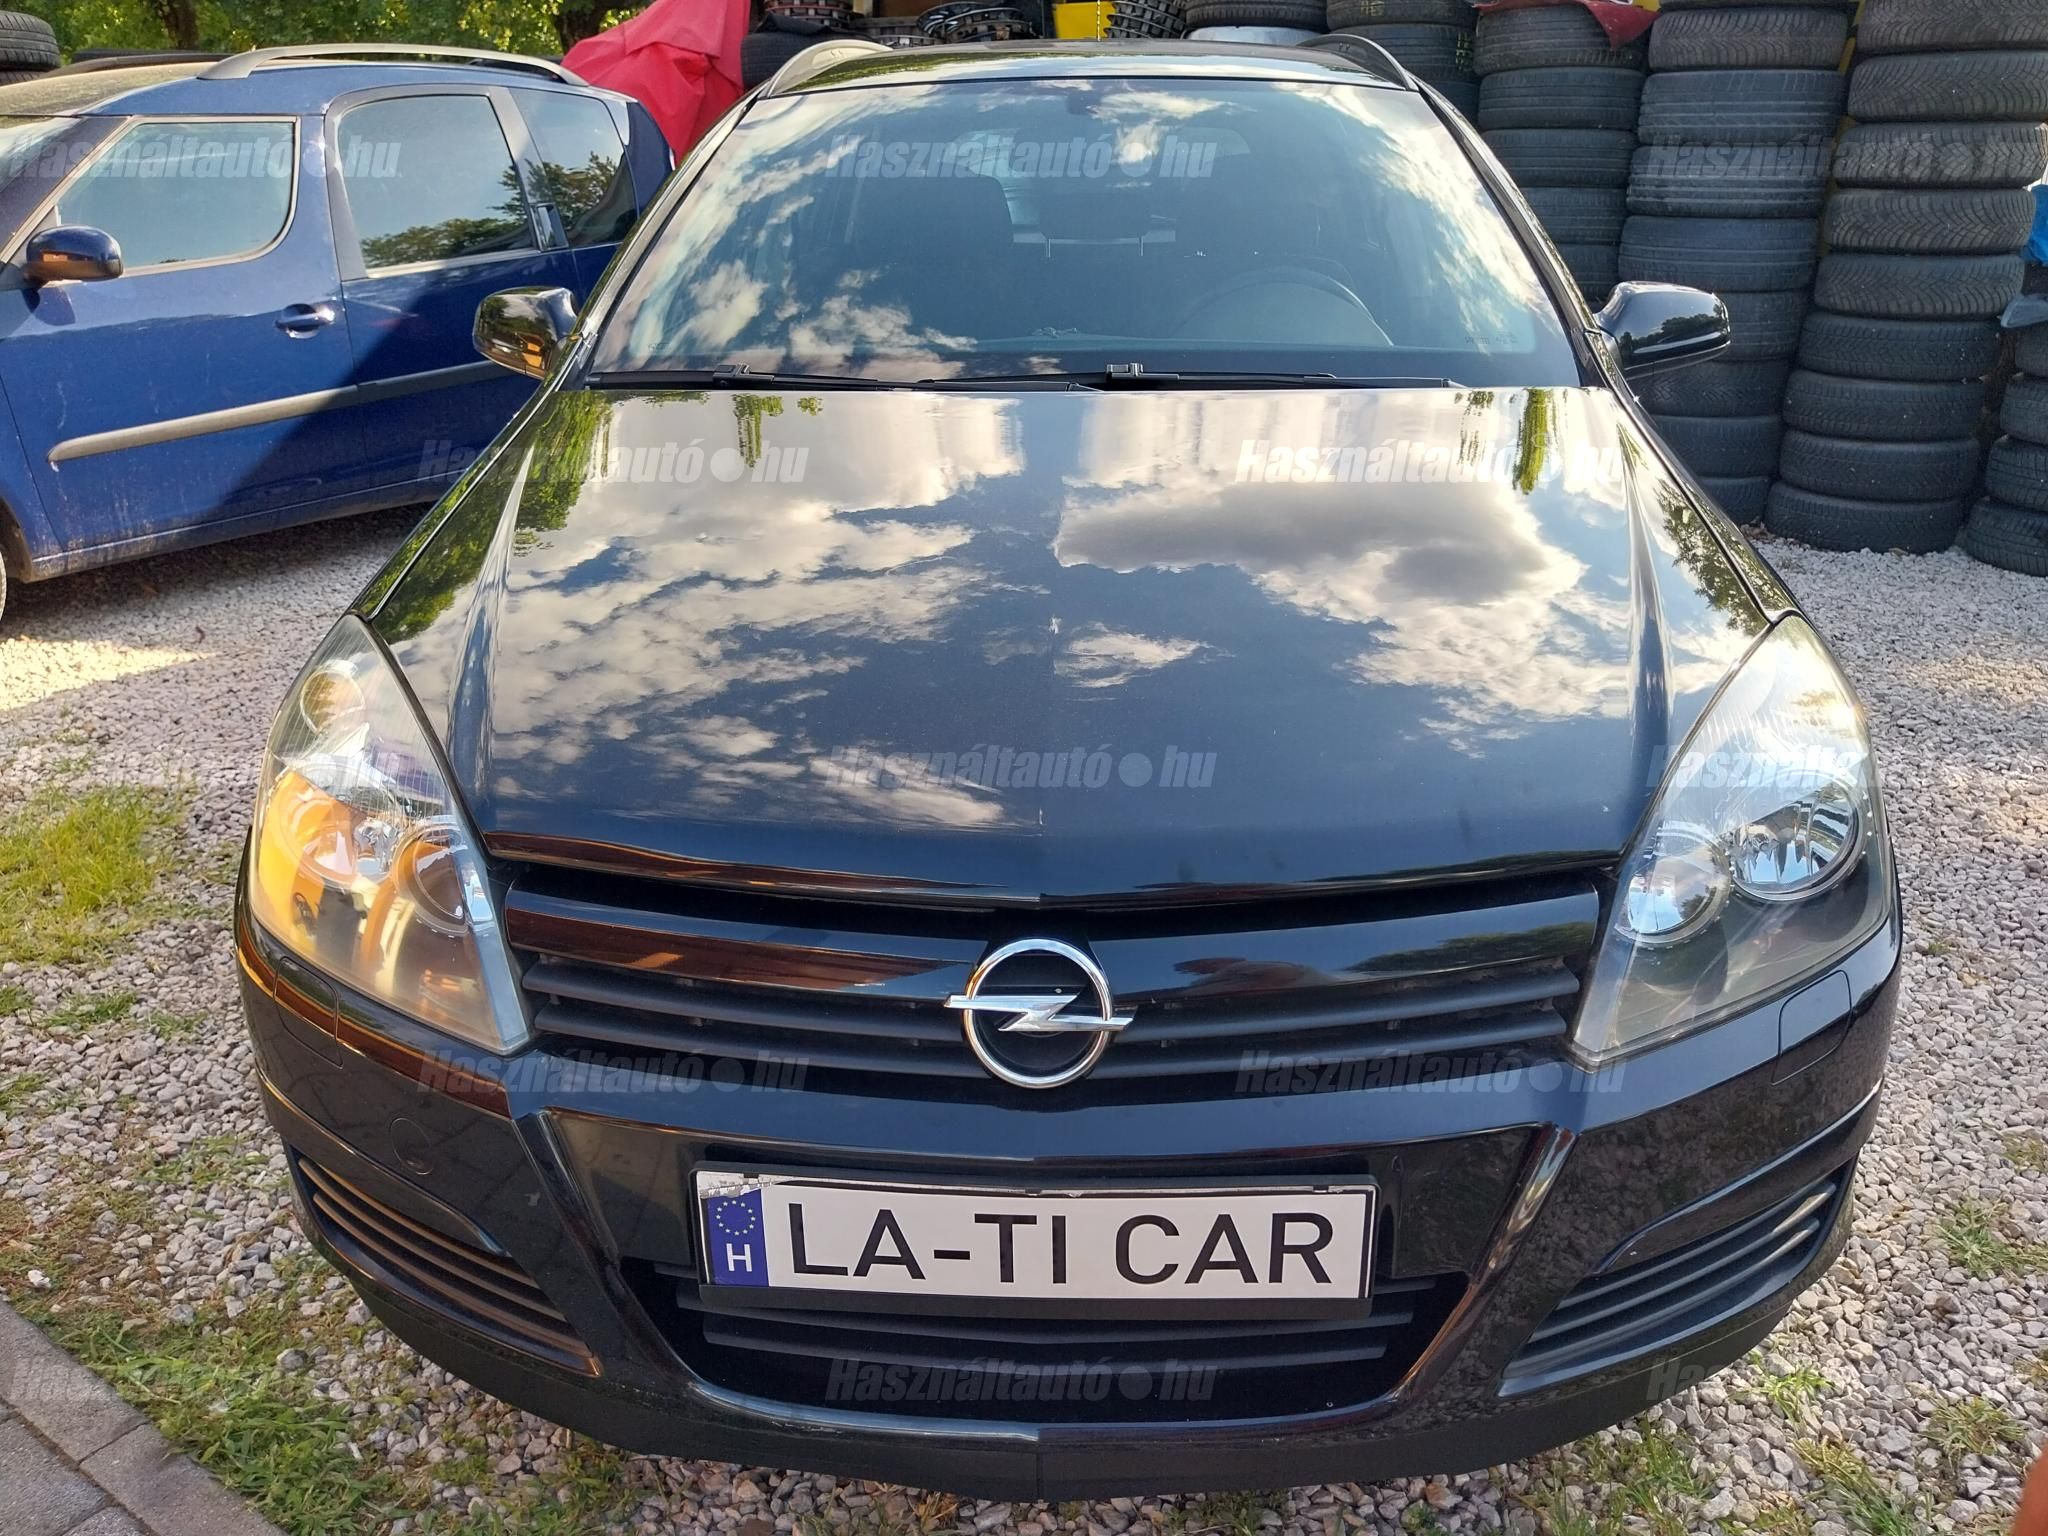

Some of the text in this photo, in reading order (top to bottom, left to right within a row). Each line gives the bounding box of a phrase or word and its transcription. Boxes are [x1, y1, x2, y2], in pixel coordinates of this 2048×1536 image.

[726, 1243, 753, 1273] H
[788, 1203, 1333, 1285] LA-TI CAR
